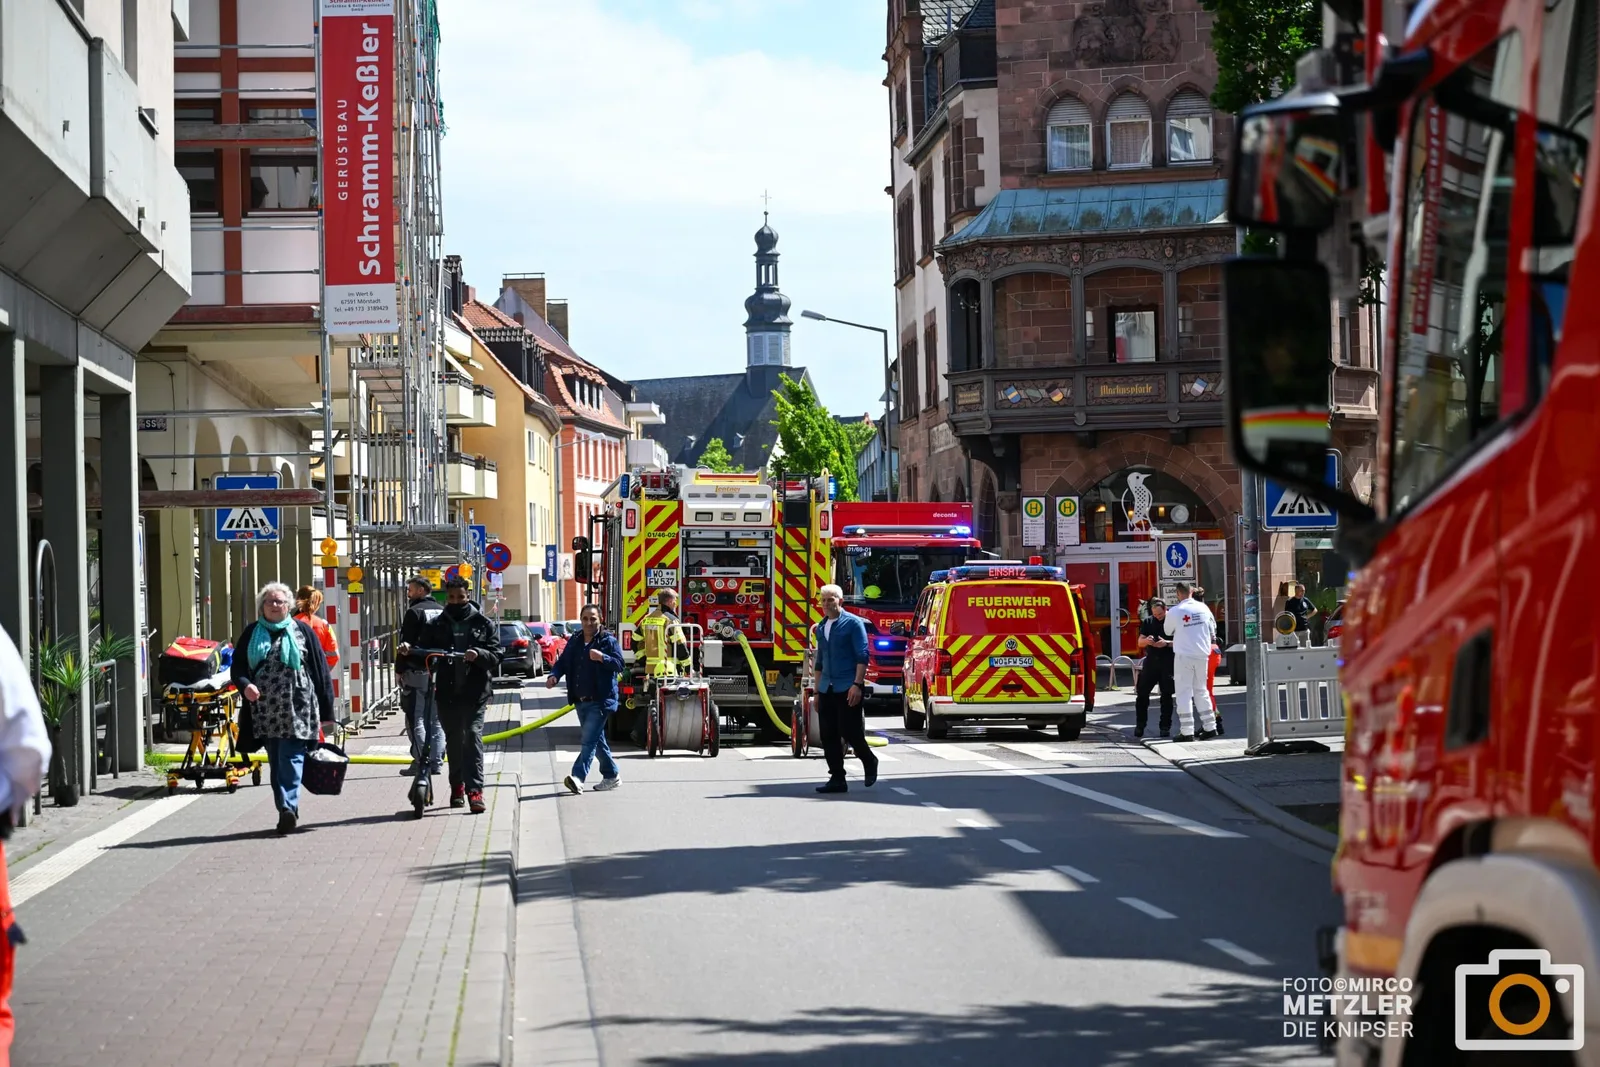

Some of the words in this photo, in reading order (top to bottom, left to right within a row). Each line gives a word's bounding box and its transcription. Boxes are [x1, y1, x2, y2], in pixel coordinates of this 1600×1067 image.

[336, 99, 348, 201] GERÜSTBAU
[356, 22, 382, 276] Schramm-Keßler
[988, 567, 1027, 577] EINSATZ
[660, 577, 675, 585] 537
[967, 596, 1052, 607] FEUERWEHR
[983, 608, 1037, 619] WORMS
[1018, 657, 1033, 665] 540
